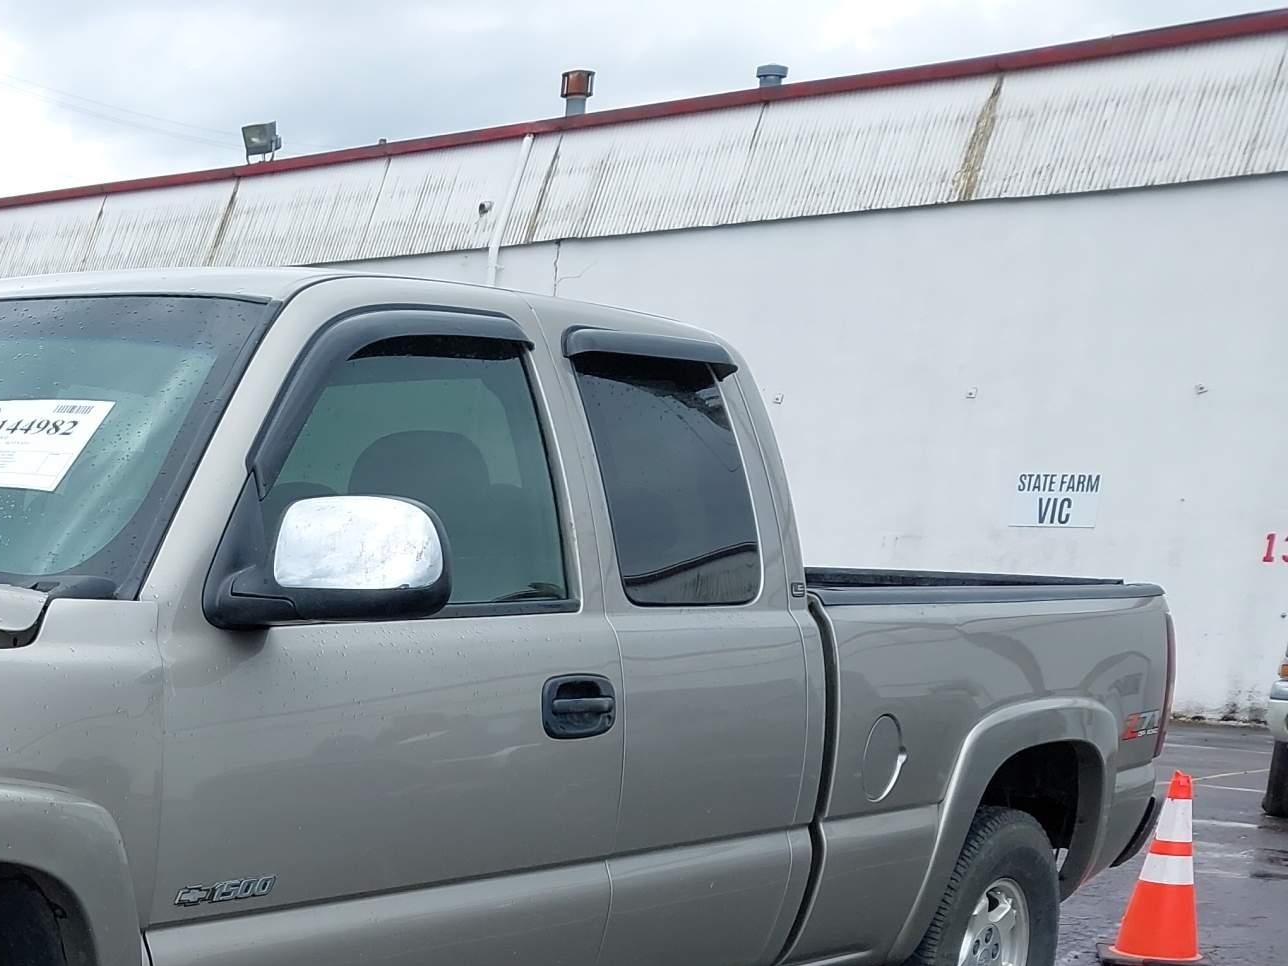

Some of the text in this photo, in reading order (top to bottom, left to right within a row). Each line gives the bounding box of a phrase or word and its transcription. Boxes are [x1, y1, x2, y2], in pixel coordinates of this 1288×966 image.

[1018, 473, 1100, 492] STATE FARM
[1038, 497, 1073, 524] VIC
[1121, 710, 1160, 740] Z71
[210, 876, 276, 902] 1500
